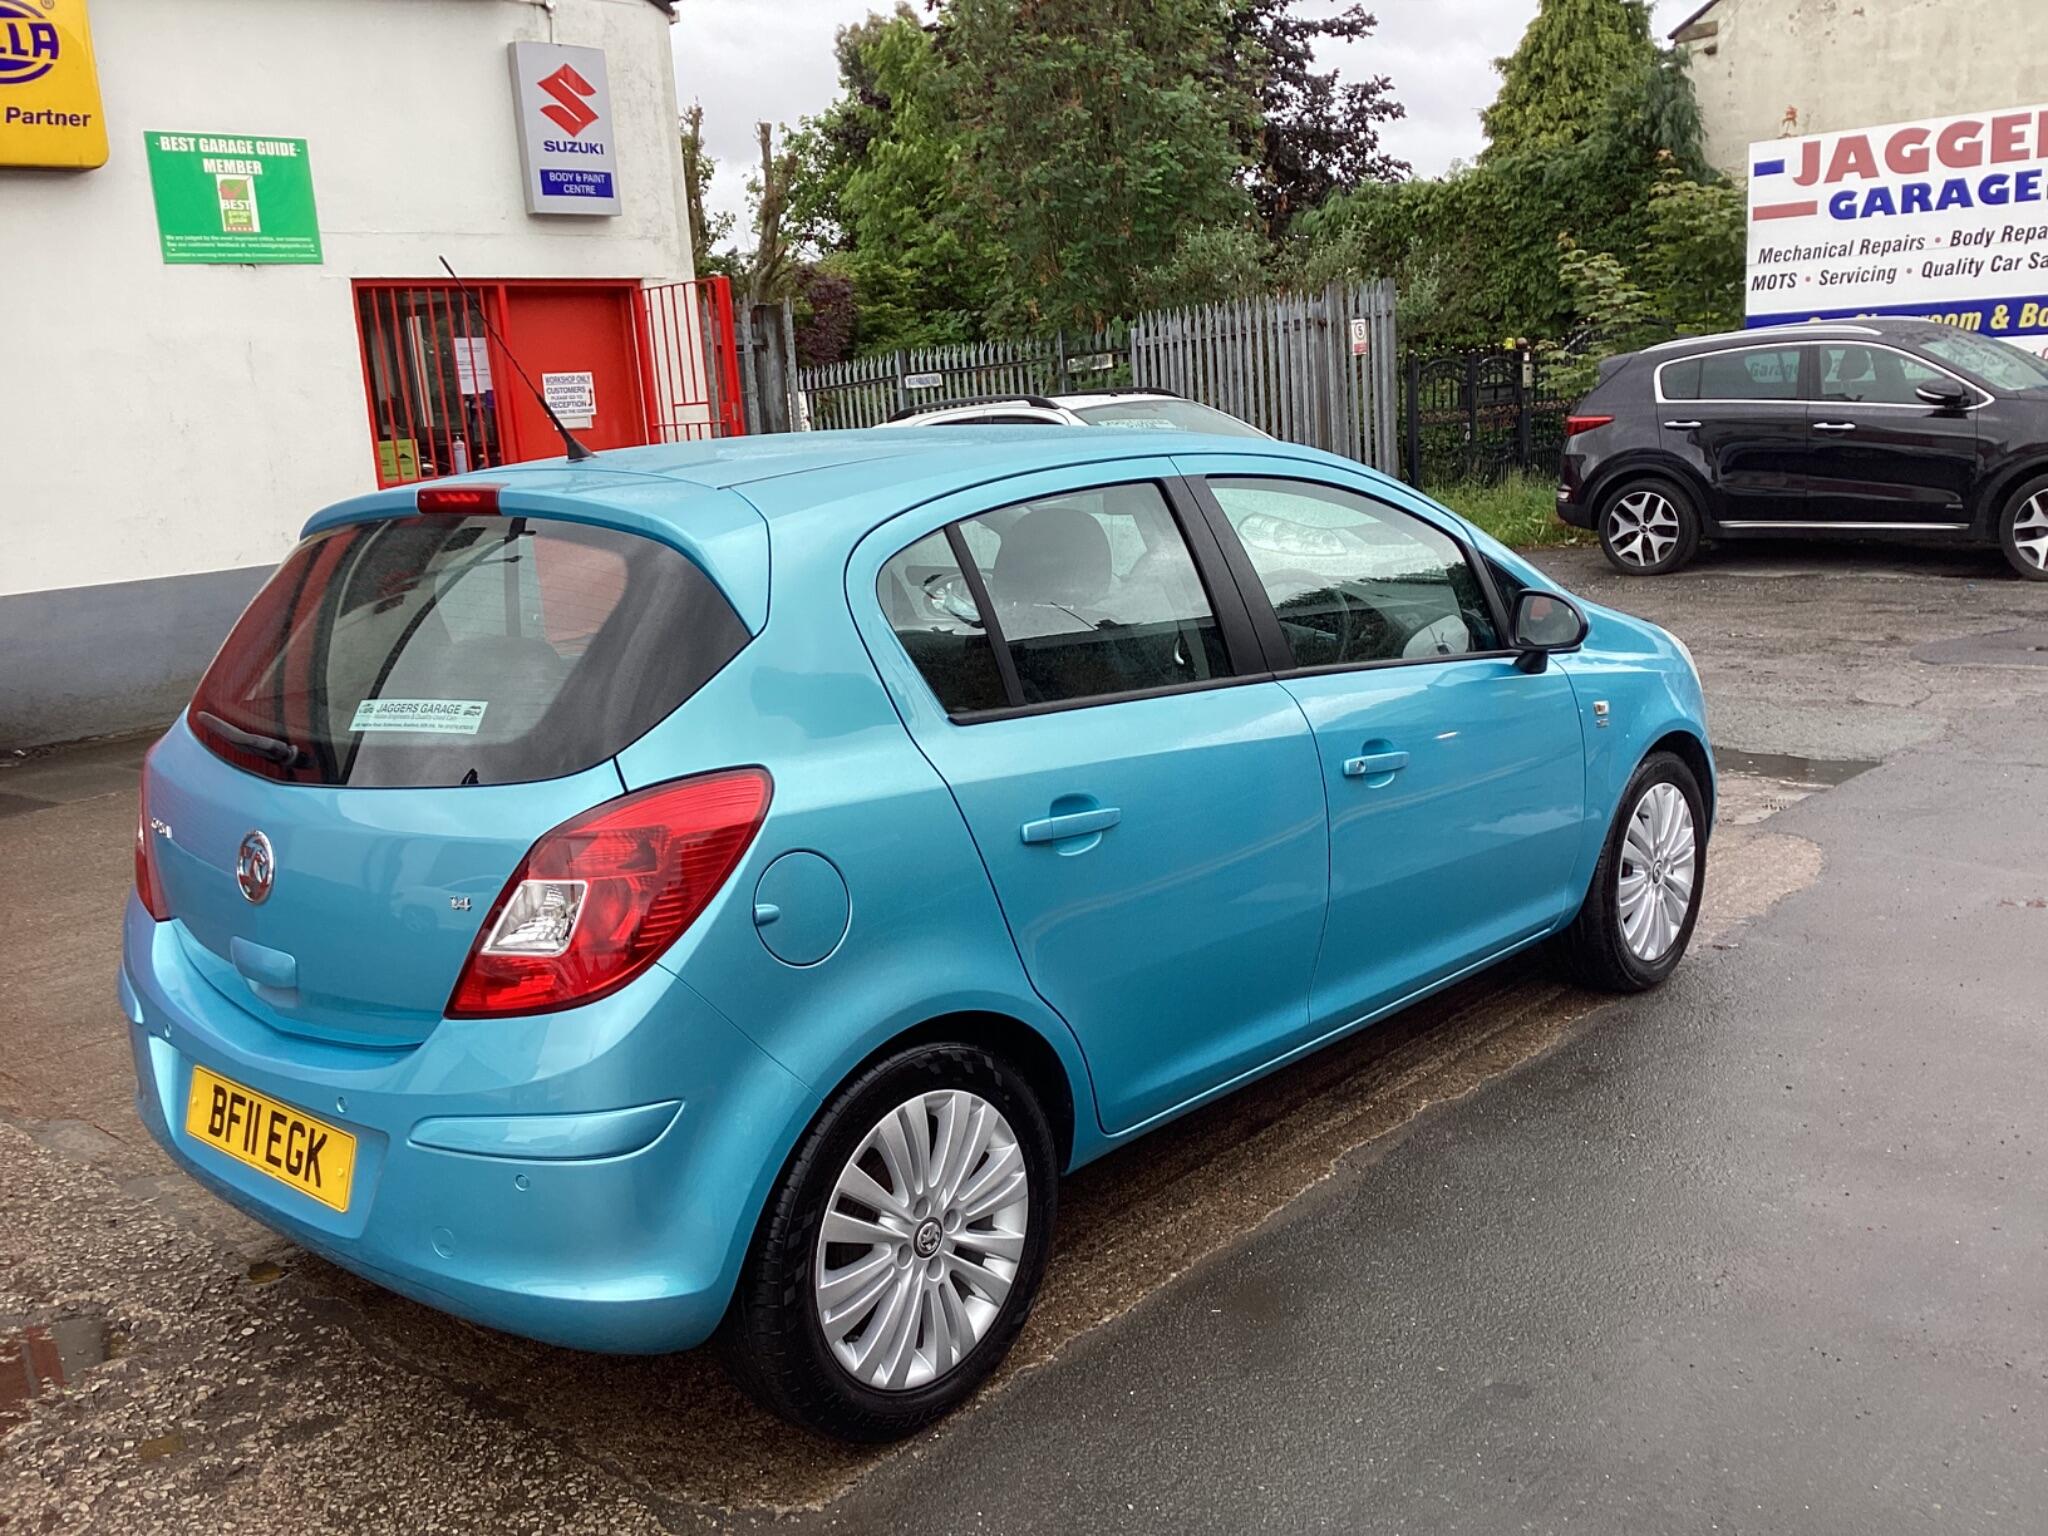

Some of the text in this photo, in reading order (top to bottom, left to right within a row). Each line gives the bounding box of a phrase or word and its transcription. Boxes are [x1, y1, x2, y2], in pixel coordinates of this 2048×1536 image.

[5, 106, 92, 127] Partner
[159, 135, 297, 158] BEST GARAGE GUIDE
[543, 139, 605, 156] SUZUKI
[1793, 110, 2048, 187] JAGGE
[202, 157, 263, 176] MEMBER
[548, 171, 575, 183] BODY
[582, 174, 606, 184] PAINT
[562, 183, 597, 195] CENTRE
[221, 198, 250, 211] BEST
[1757, 239, 1854, 265] Mechanical
[1859, 233, 1926, 258] Repairs
[1949, 226, 1996, 248] Body
[1751, 272, 1798, 292] MOTS
[1818, 264, 1898, 286] Servicing
[1921, 256, 1986, 279] Quality
[1990, 254, 2024, 273] Car
[1989, 303, 2011, 330] &
[545, 374, 591, 385] WORKSHOP ONLY
[546, 386, 586, 395] CUSTOMERS
[376, 703, 462, 715] JAGGERS GARAGE
[207, 1083, 329, 1189] BF11 EGK
